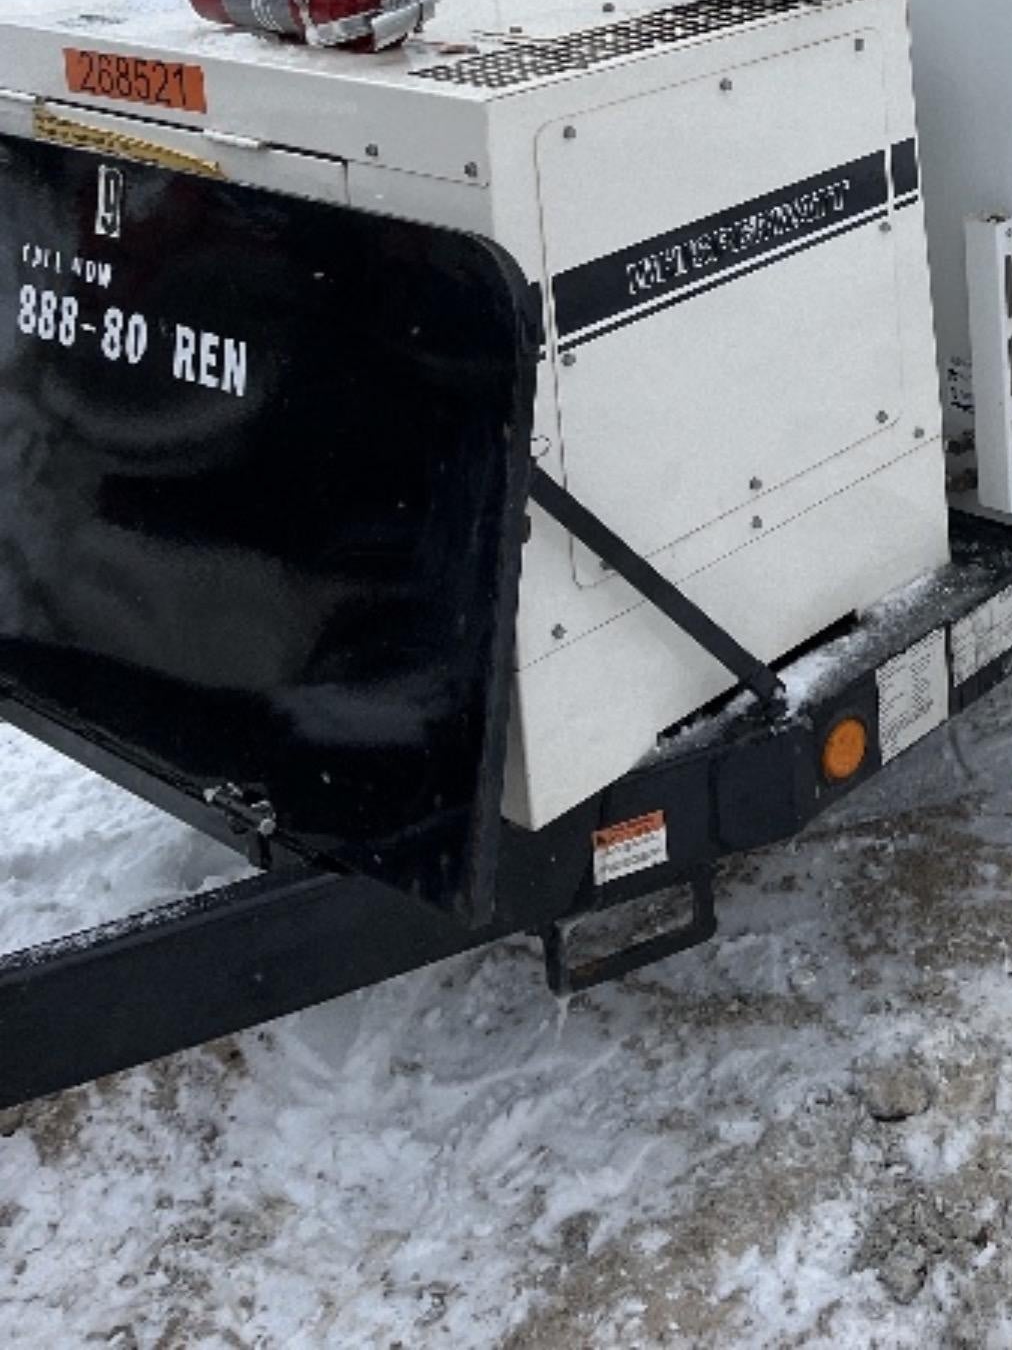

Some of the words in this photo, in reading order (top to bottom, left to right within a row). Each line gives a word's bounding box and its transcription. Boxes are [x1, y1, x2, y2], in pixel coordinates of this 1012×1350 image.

[79, 51, 187, 107] 268521
[17, 283, 148, 365] 888-80
[172, 323, 247, 397] REN
